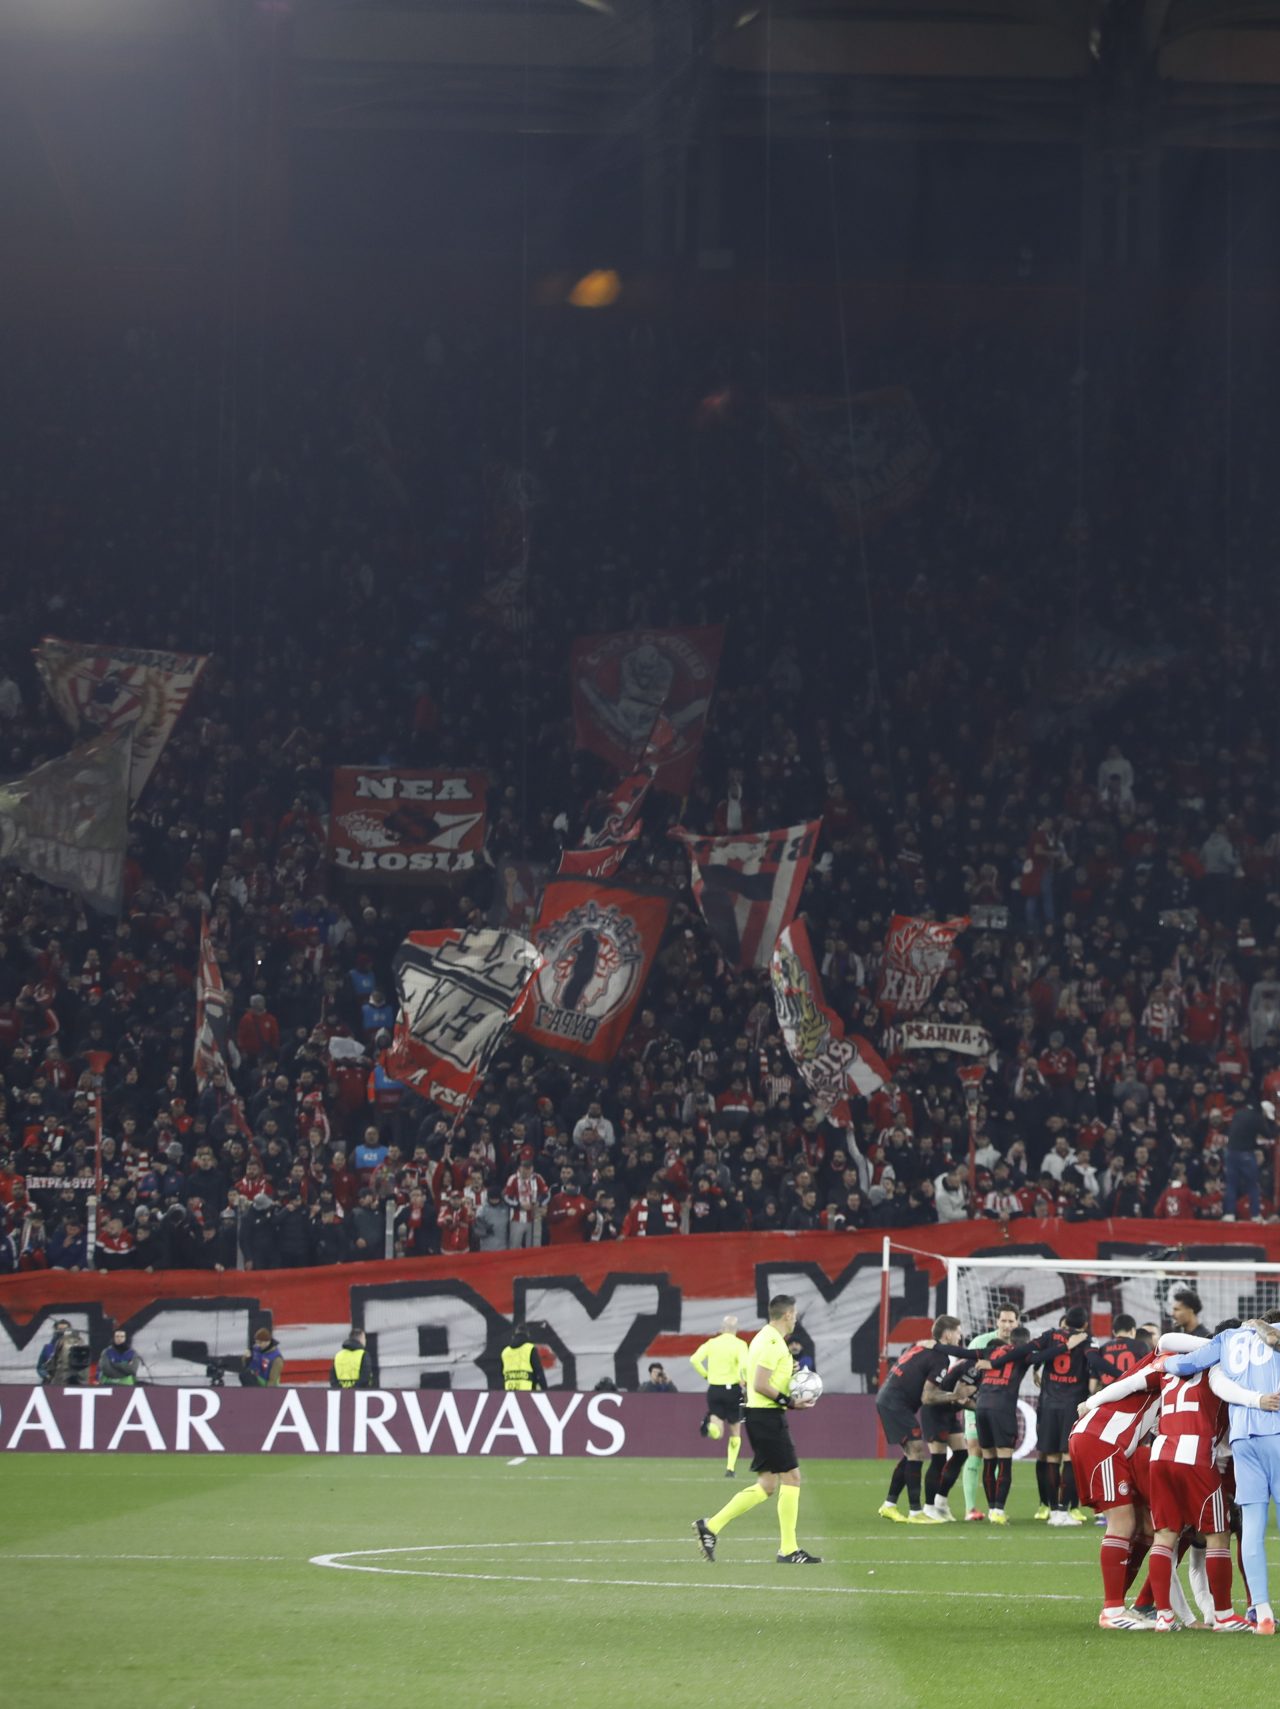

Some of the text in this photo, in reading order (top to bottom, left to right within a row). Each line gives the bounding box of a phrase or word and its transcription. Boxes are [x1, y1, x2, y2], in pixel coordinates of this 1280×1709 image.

[354, 775, 474, 801] NEA
[334, 846, 475, 872] LIOSIA
[1161, 1371, 1200, 1415] 22
[0, 1386, 626, 1457] ATAR AIRWAYS
